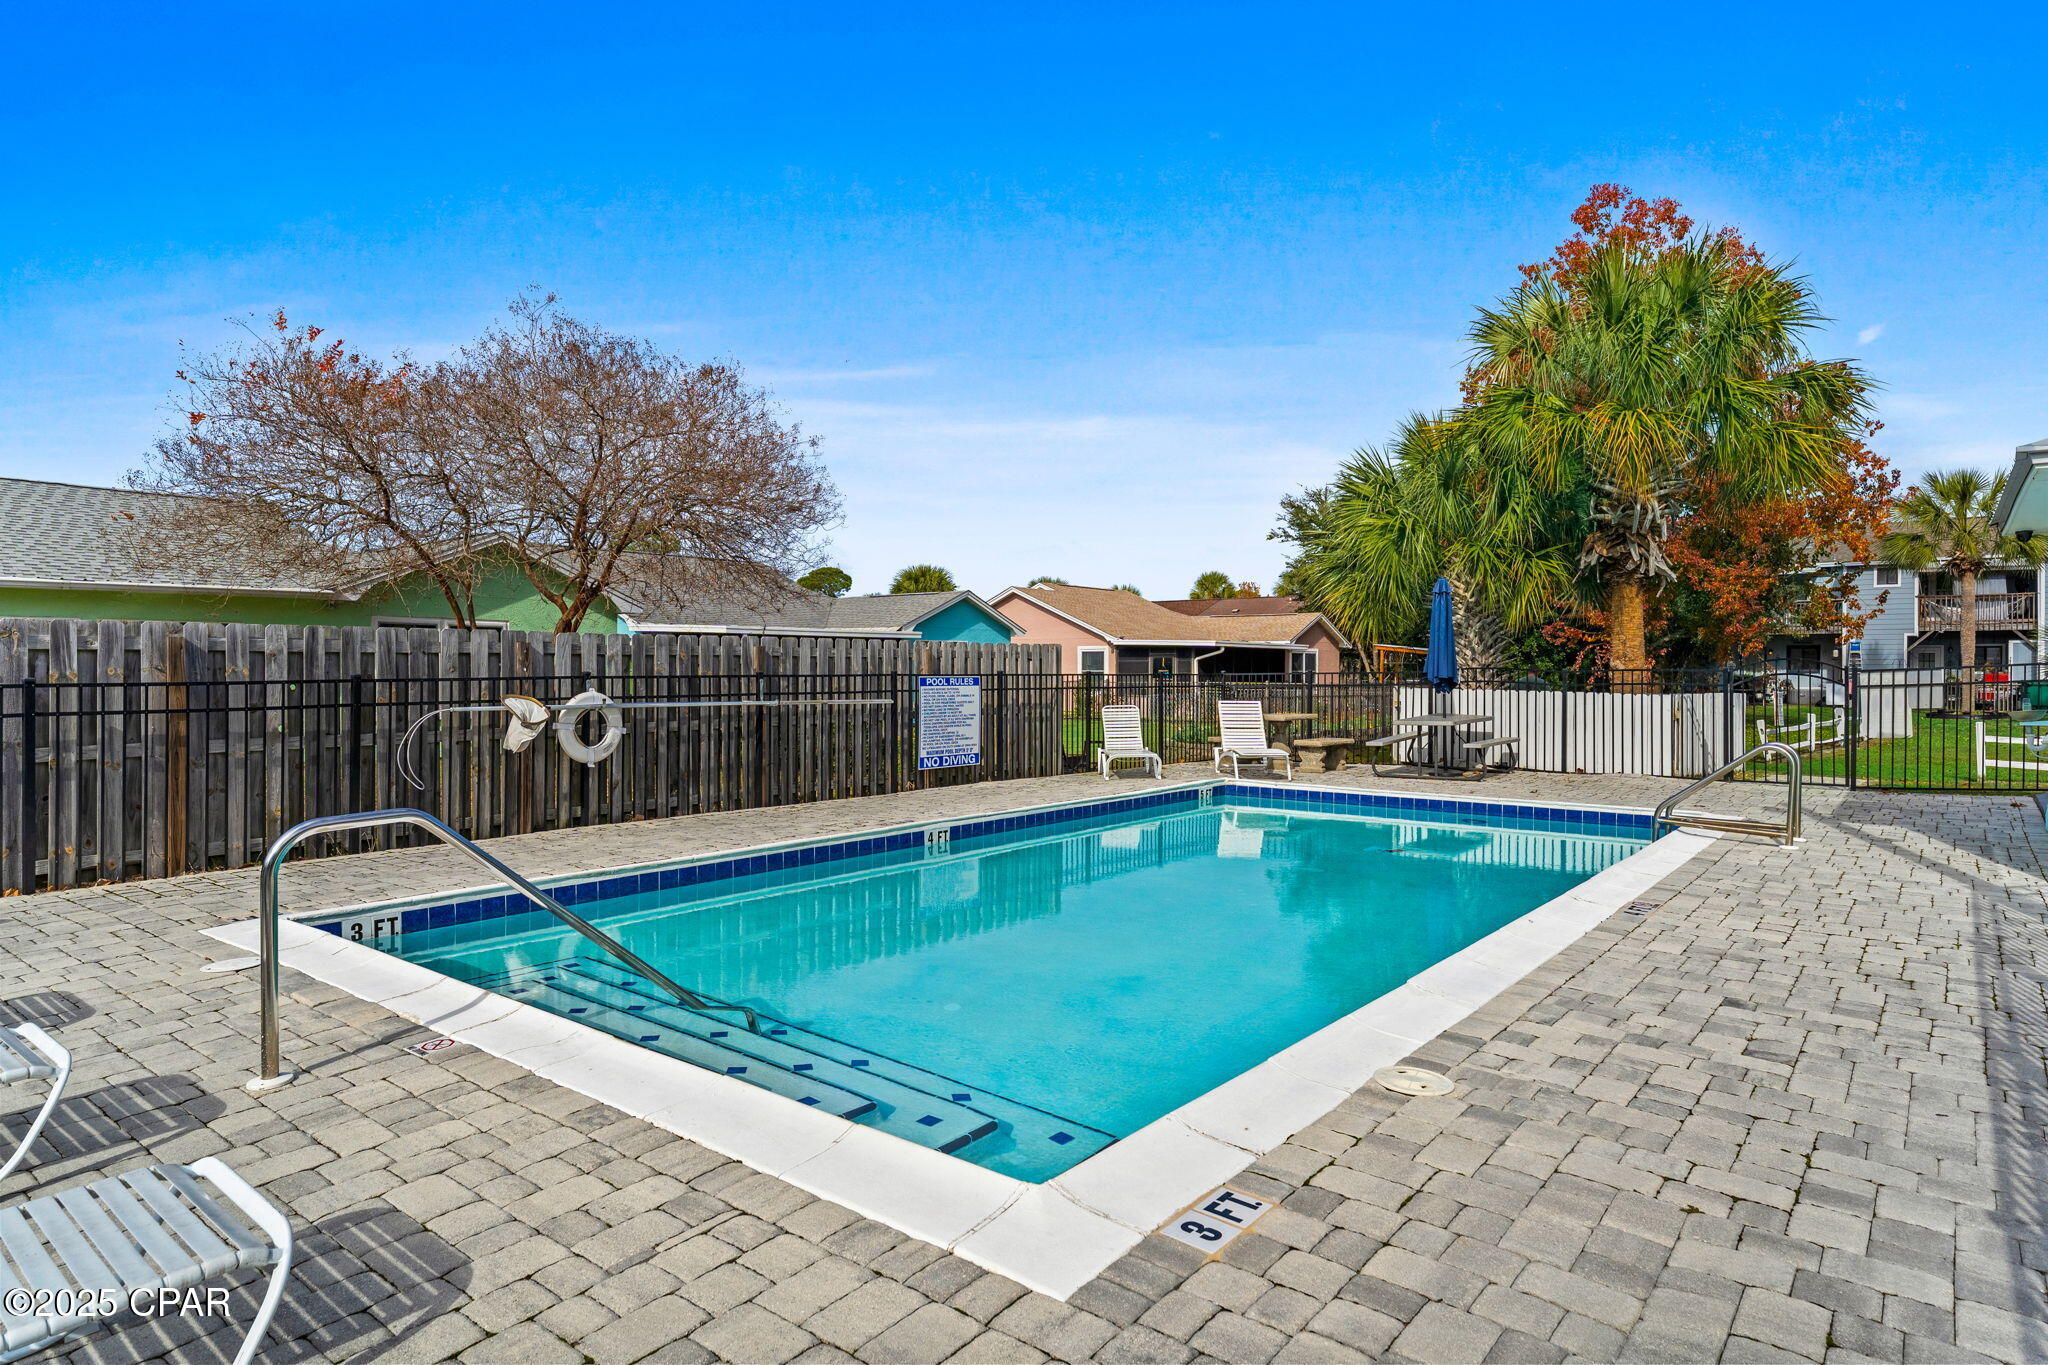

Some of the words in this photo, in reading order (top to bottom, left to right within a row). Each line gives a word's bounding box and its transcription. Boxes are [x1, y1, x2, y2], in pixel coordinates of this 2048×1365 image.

[926, 678, 947, 686] POOL
[949, 678, 974, 686] RULES
[923, 757, 940, 768] NO
[942, 754, 976, 766] DIVING
[928, 832, 934, 845] 4
[350, 922, 364, 941] 3
[373, 916, 400, 938] FT.
[1180, 1220, 1223, 1242] 3
[1202, 1190, 1263, 1224] FT.
